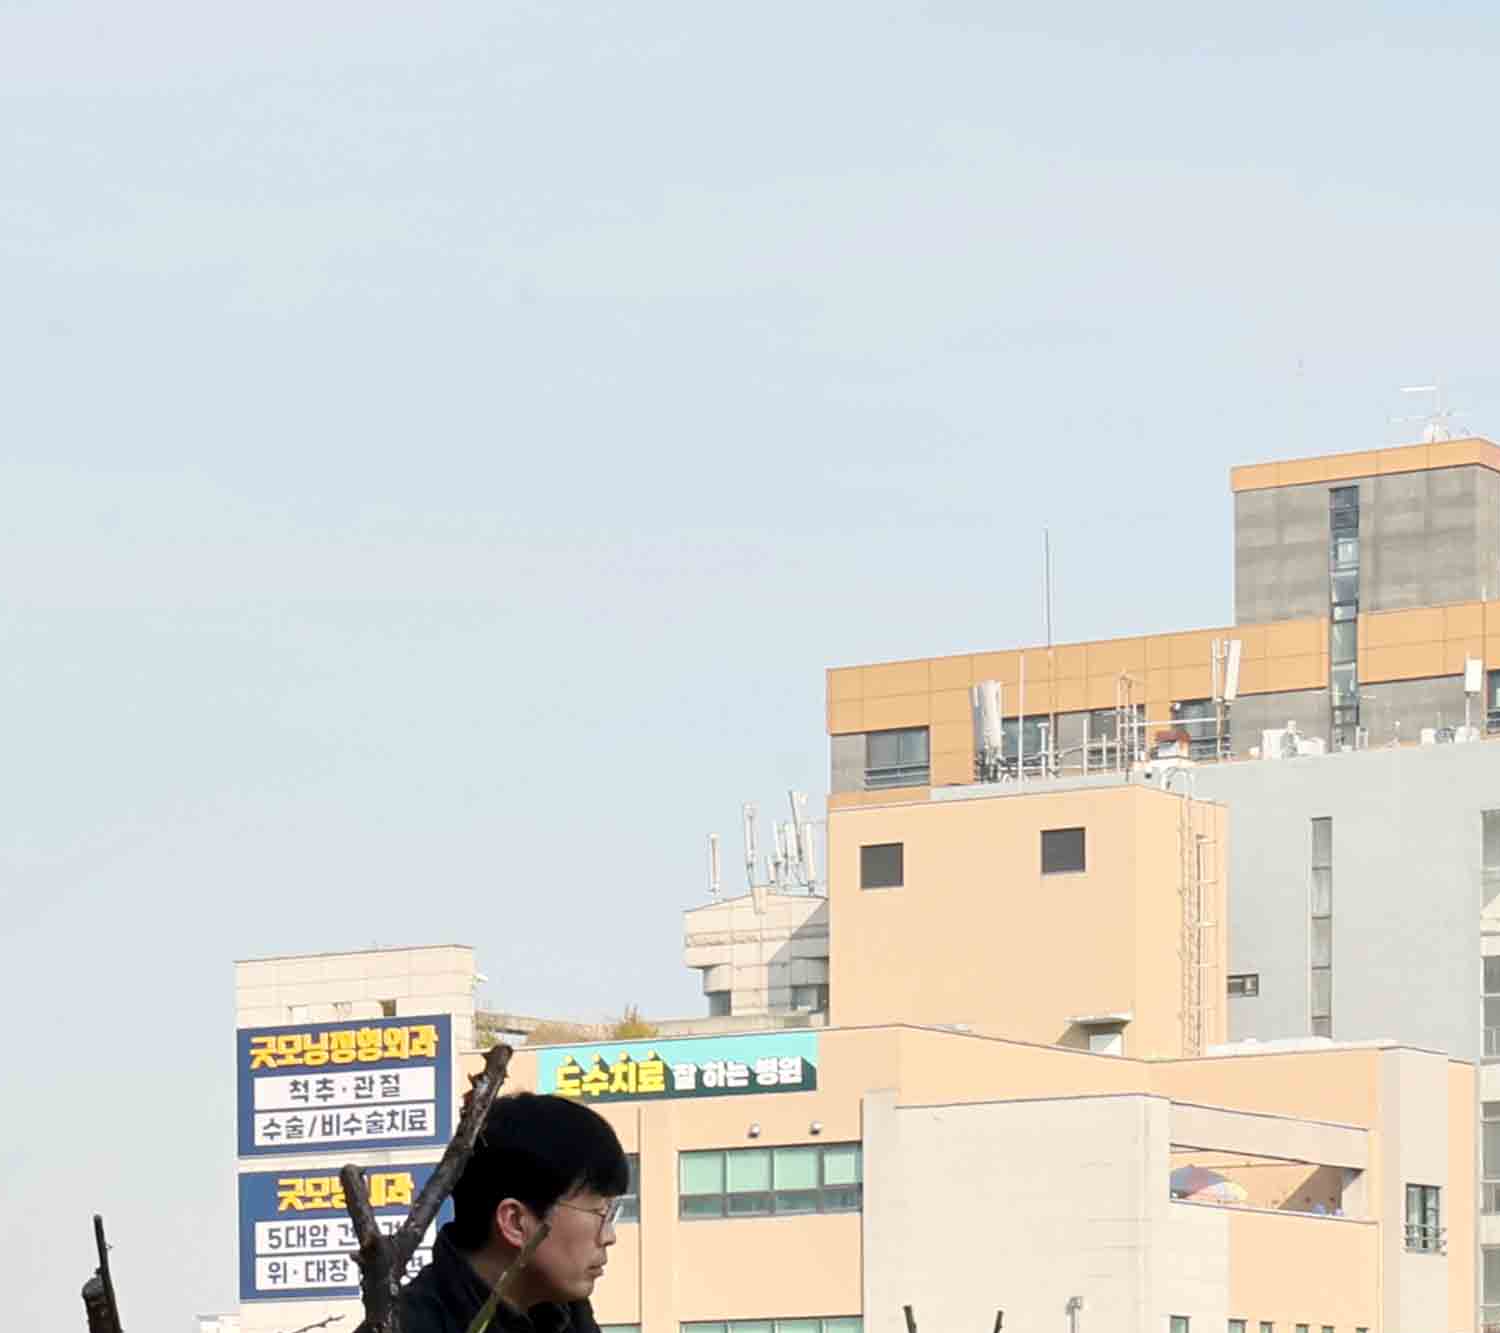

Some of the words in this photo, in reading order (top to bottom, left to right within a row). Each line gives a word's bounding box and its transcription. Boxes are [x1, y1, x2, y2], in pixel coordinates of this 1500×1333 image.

[556, 1057, 666, 1097] 도수치료
[702, 1060, 750, 1088] 하는
[755, 1055, 803, 1086] 병원
[262, 1108, 428, 1141] 수술/비수술치료
[267, 1224, 329, 1250] 5대암
